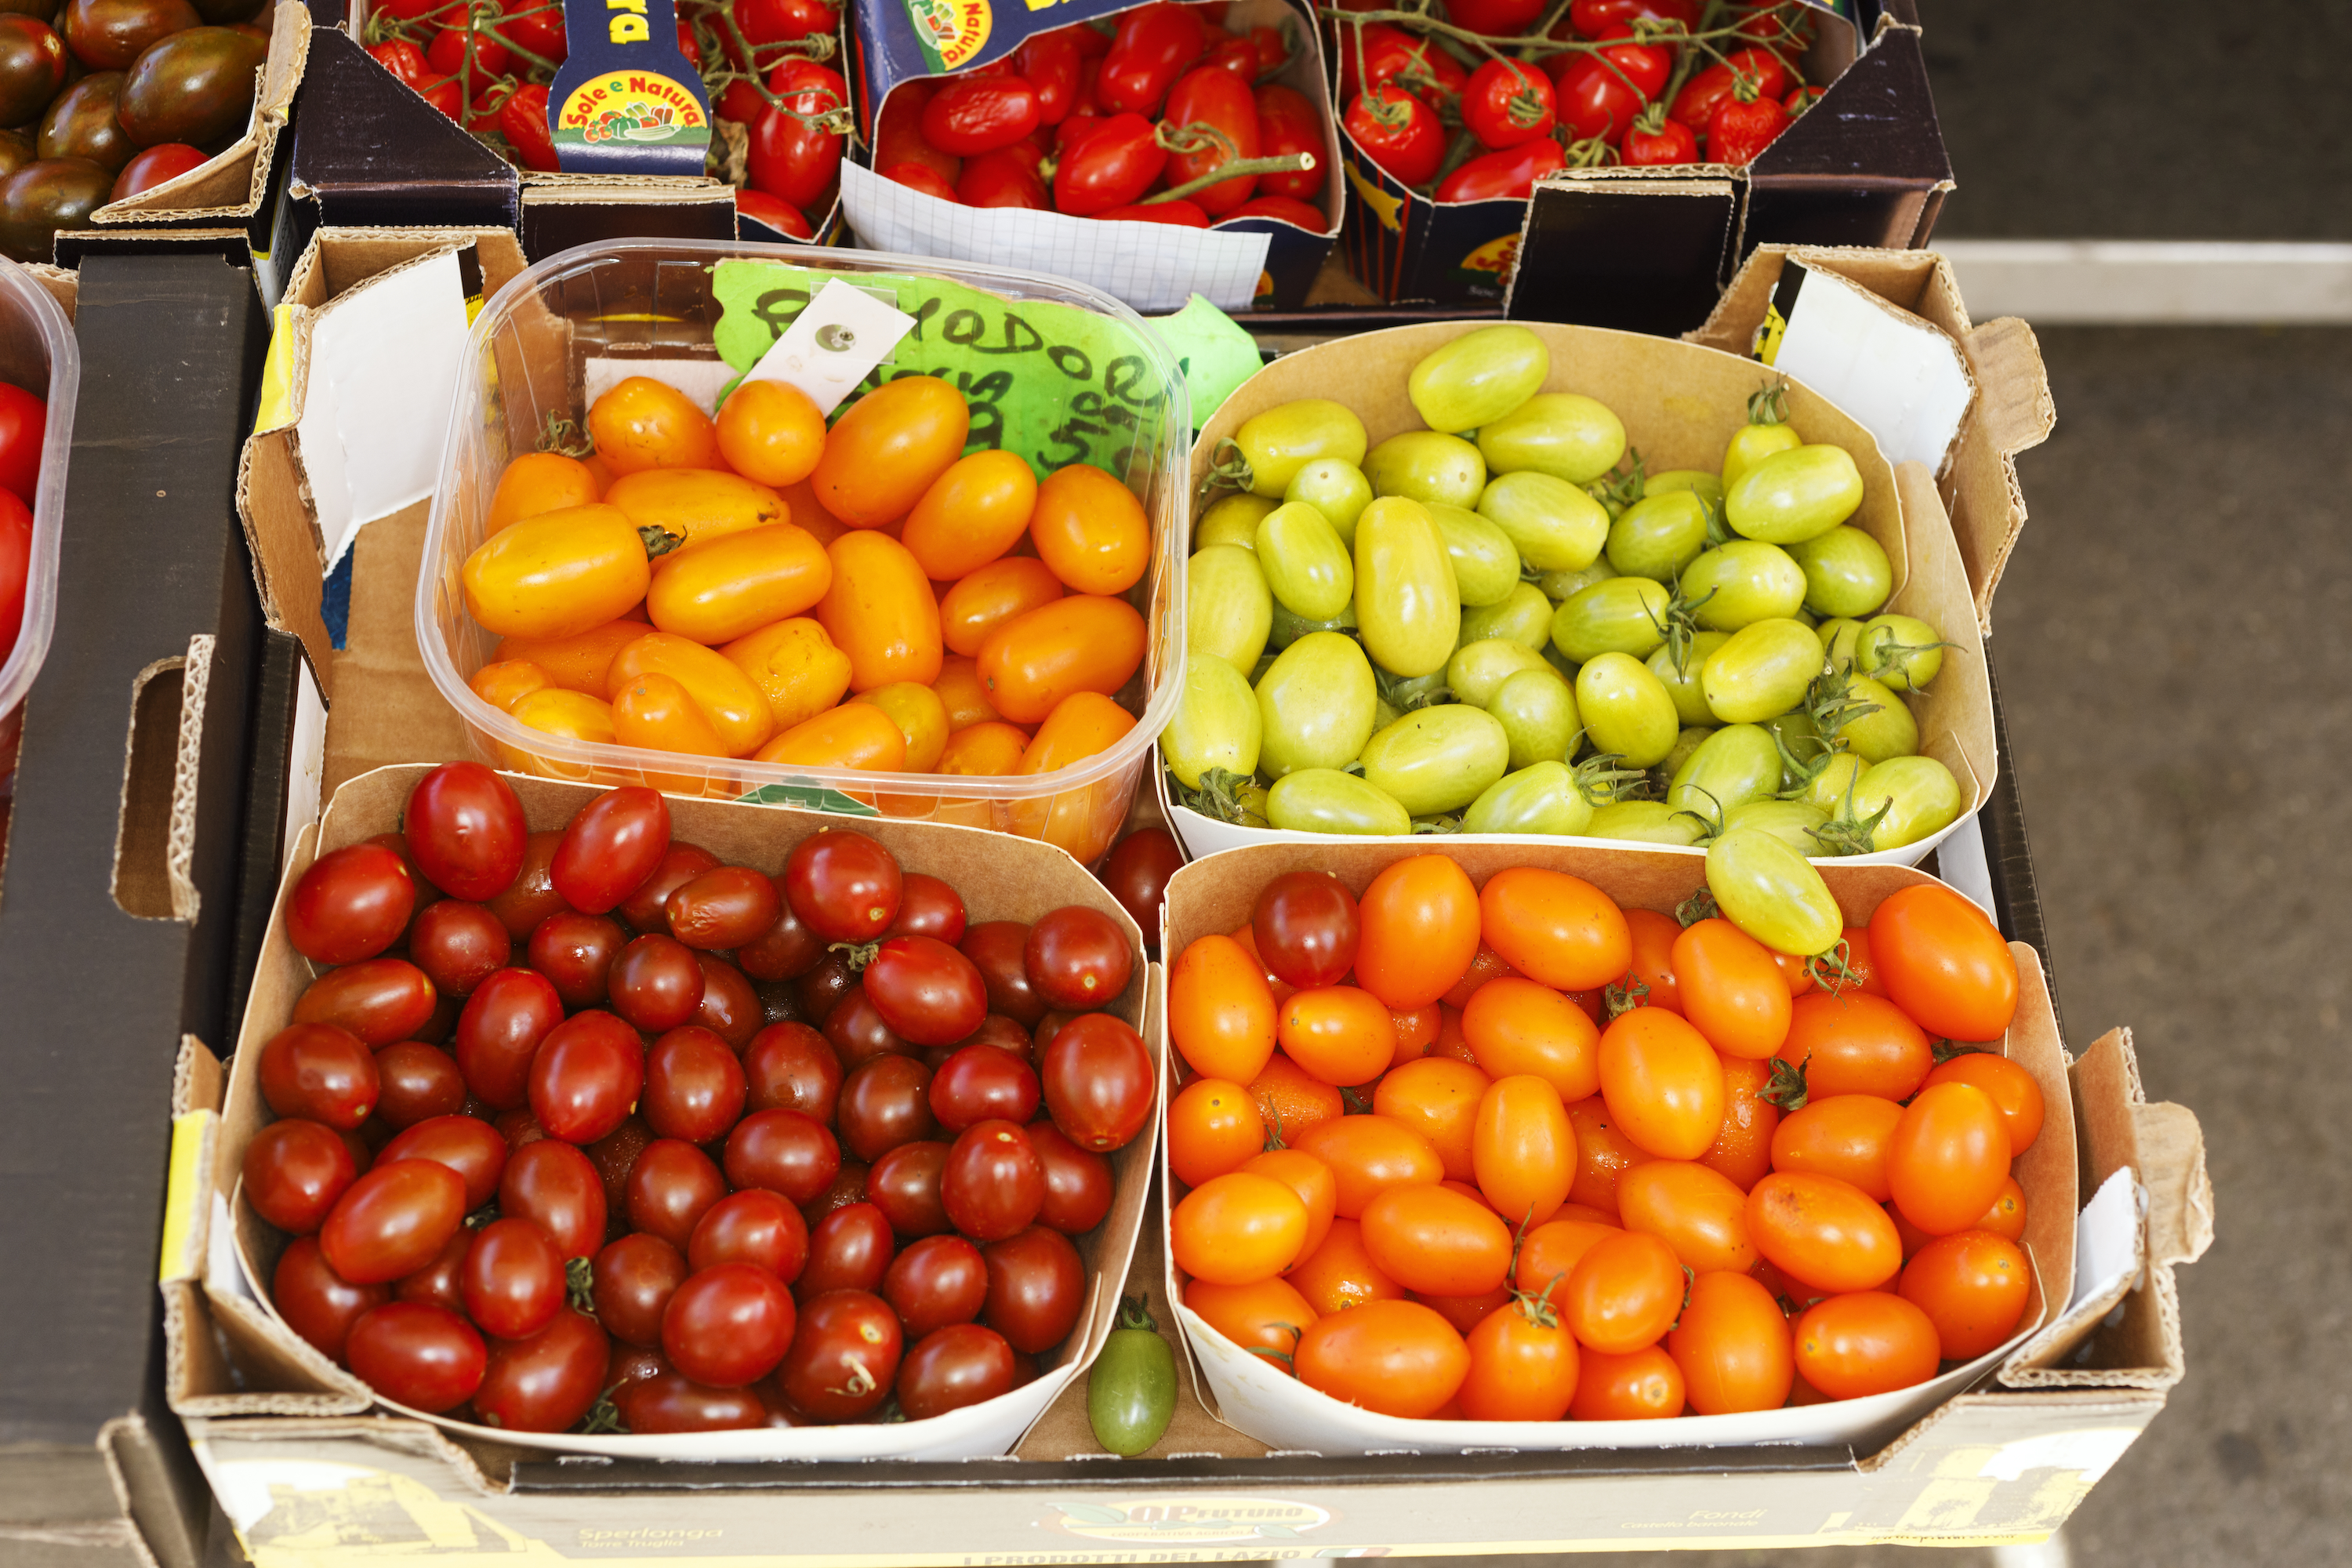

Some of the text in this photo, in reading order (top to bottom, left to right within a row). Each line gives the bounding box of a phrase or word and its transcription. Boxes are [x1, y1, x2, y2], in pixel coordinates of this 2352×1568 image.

[942, 2, 983, 64] Natura
[566, 77, 700, 126] Sole e Natura
[1198, 1507, 1304, 1519] FUTURO
[1688, 1508, 1768, 1520] Fondi
[1621, 1519, 1759, 1530] Castello baronale
[578, 1526, 724, 1542] Sperlonga
[581, 1539, 684, 1549] Torre Truglia
[964, 1549, 1301, 1567] I PRODOTTI DEL LAZIO
